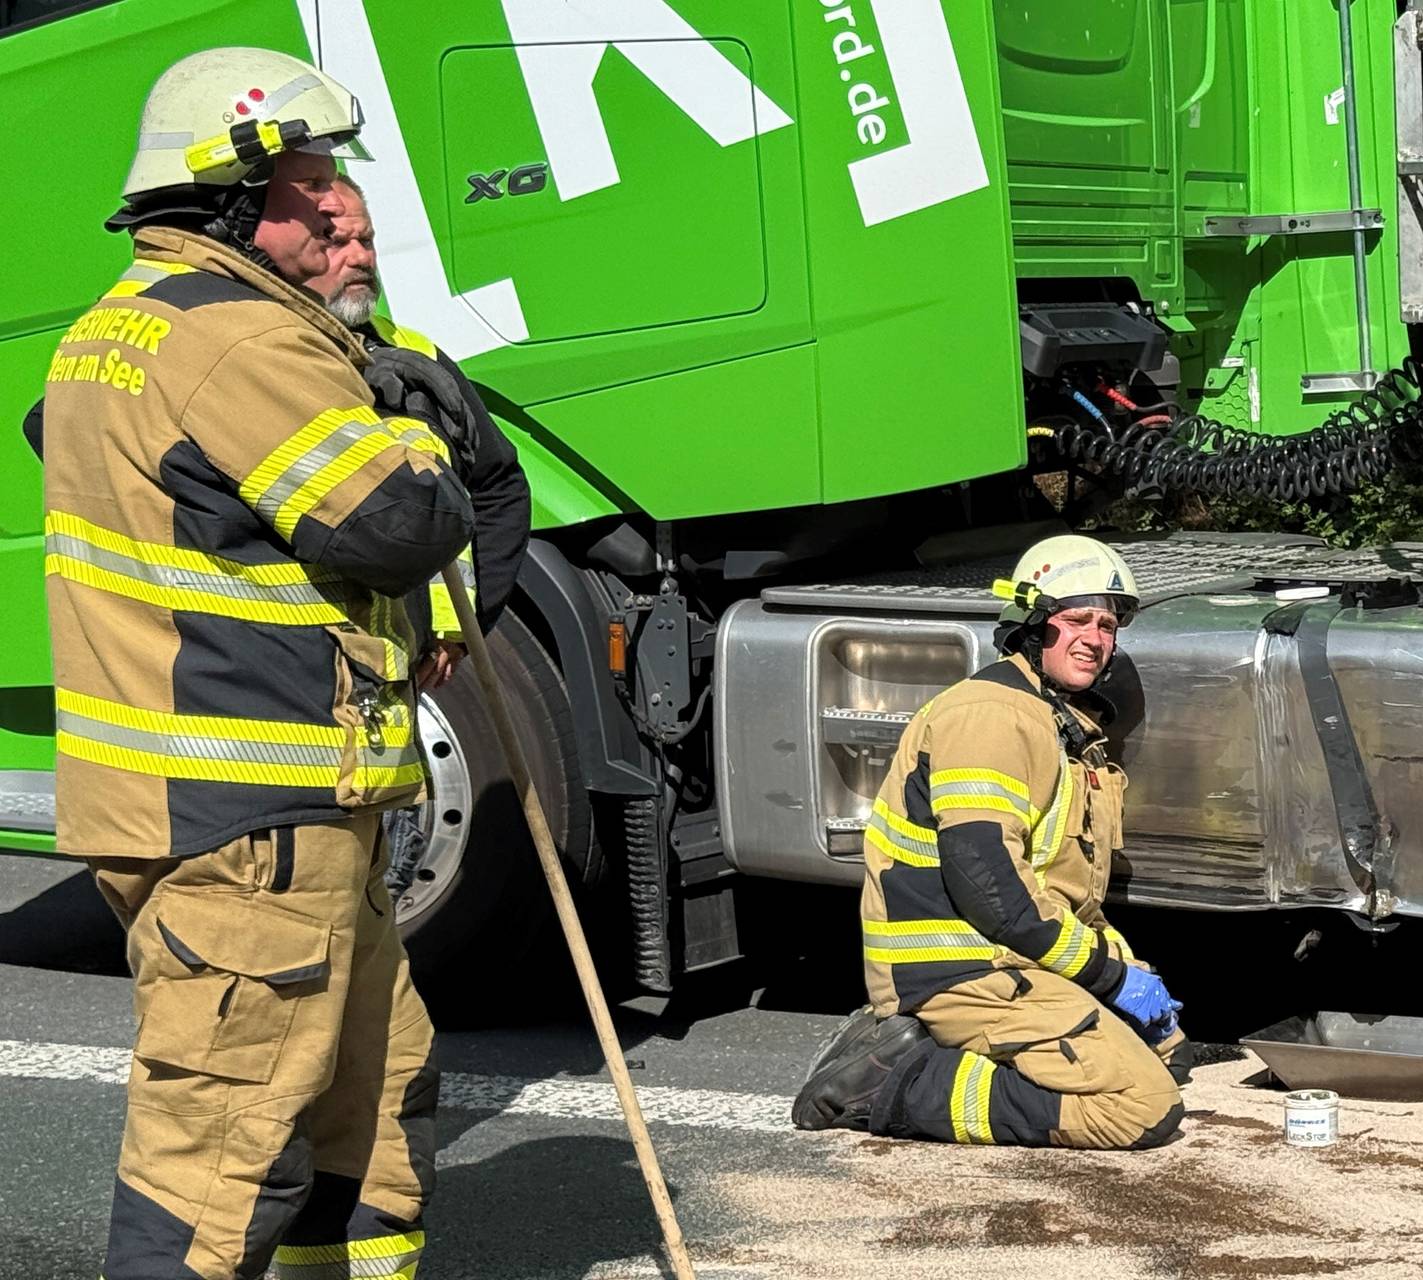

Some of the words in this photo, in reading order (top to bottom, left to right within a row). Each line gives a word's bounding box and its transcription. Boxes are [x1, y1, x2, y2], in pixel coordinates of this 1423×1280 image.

[818, 0, 890, 145] rd.de
[464, 162, 547, 204] XG
[74, 354, 100, 382] am
[99, 348, 146, 397] See
